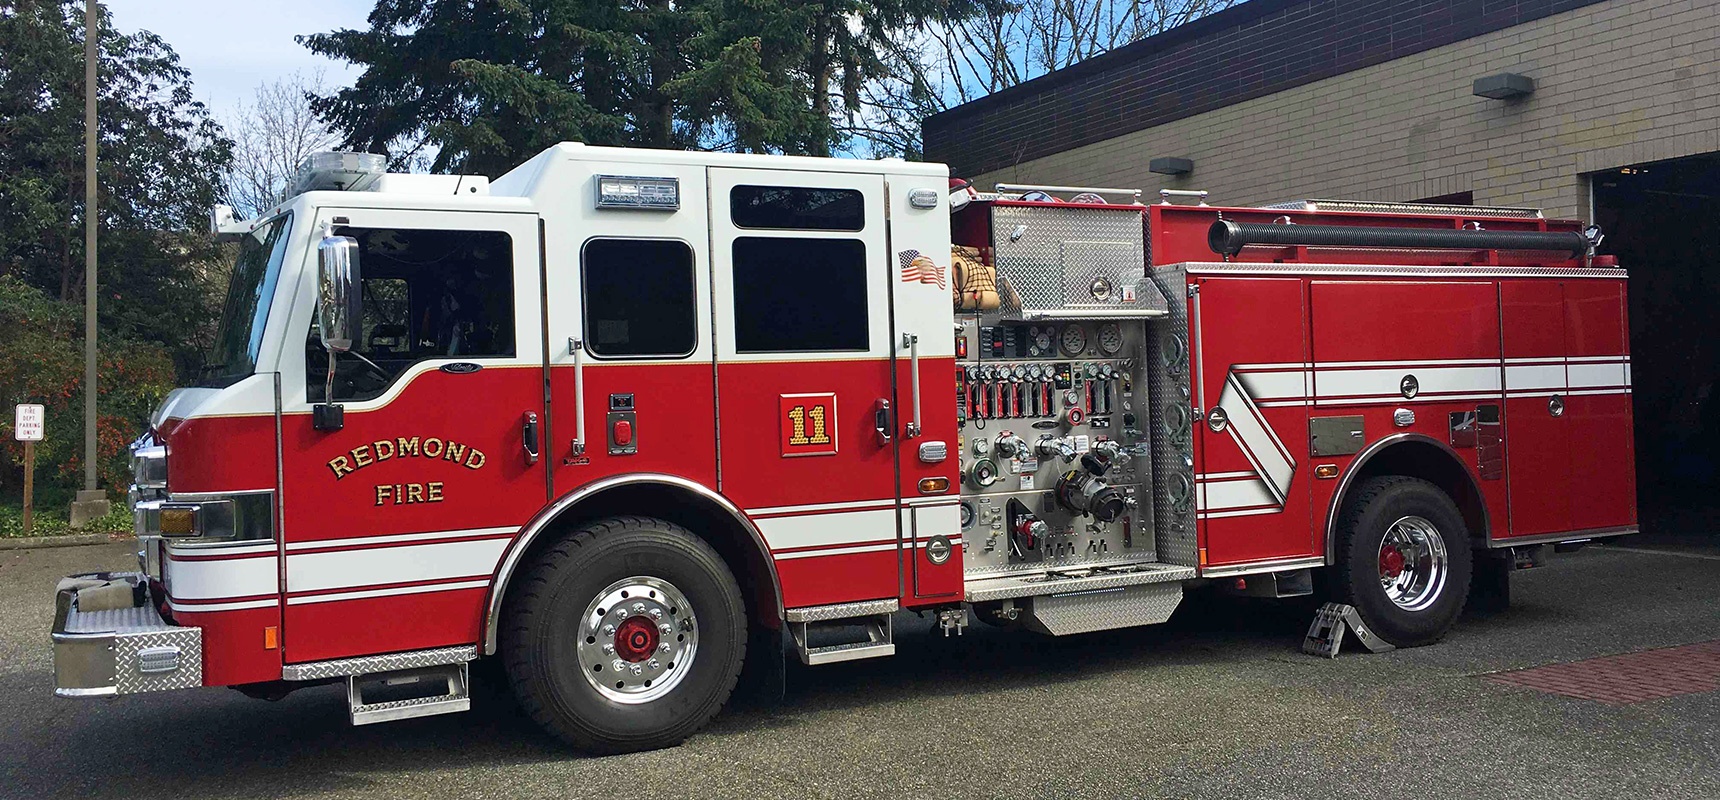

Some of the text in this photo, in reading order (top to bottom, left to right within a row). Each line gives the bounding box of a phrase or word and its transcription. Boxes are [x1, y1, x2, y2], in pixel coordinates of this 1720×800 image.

[788, 405, 830, 445] 11
[327, 436, 486, 480] REDMOND
[375, 481, 444, 506] FIRE
